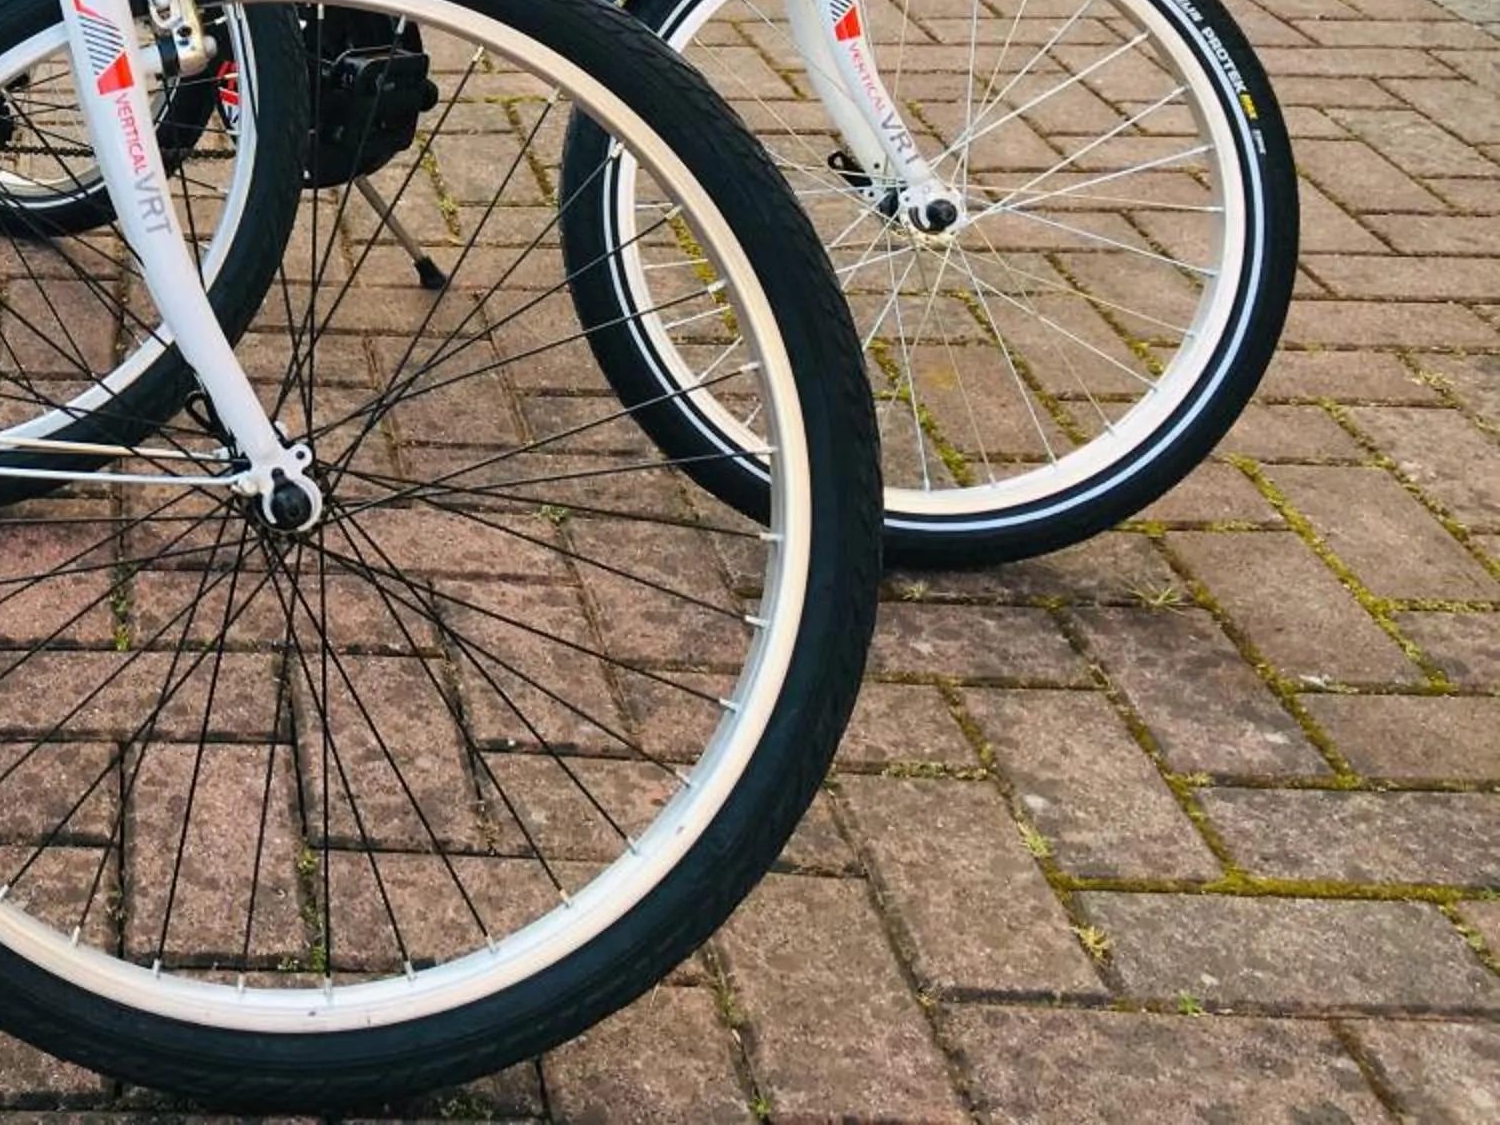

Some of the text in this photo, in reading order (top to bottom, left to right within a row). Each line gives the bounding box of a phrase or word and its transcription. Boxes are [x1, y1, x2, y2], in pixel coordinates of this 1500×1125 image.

[850, 42, 886, 114] VERTICAL
[1201, 26, 1248, 93] PROTEK
[114, 92, 173, 236] VERTICAL VRT
